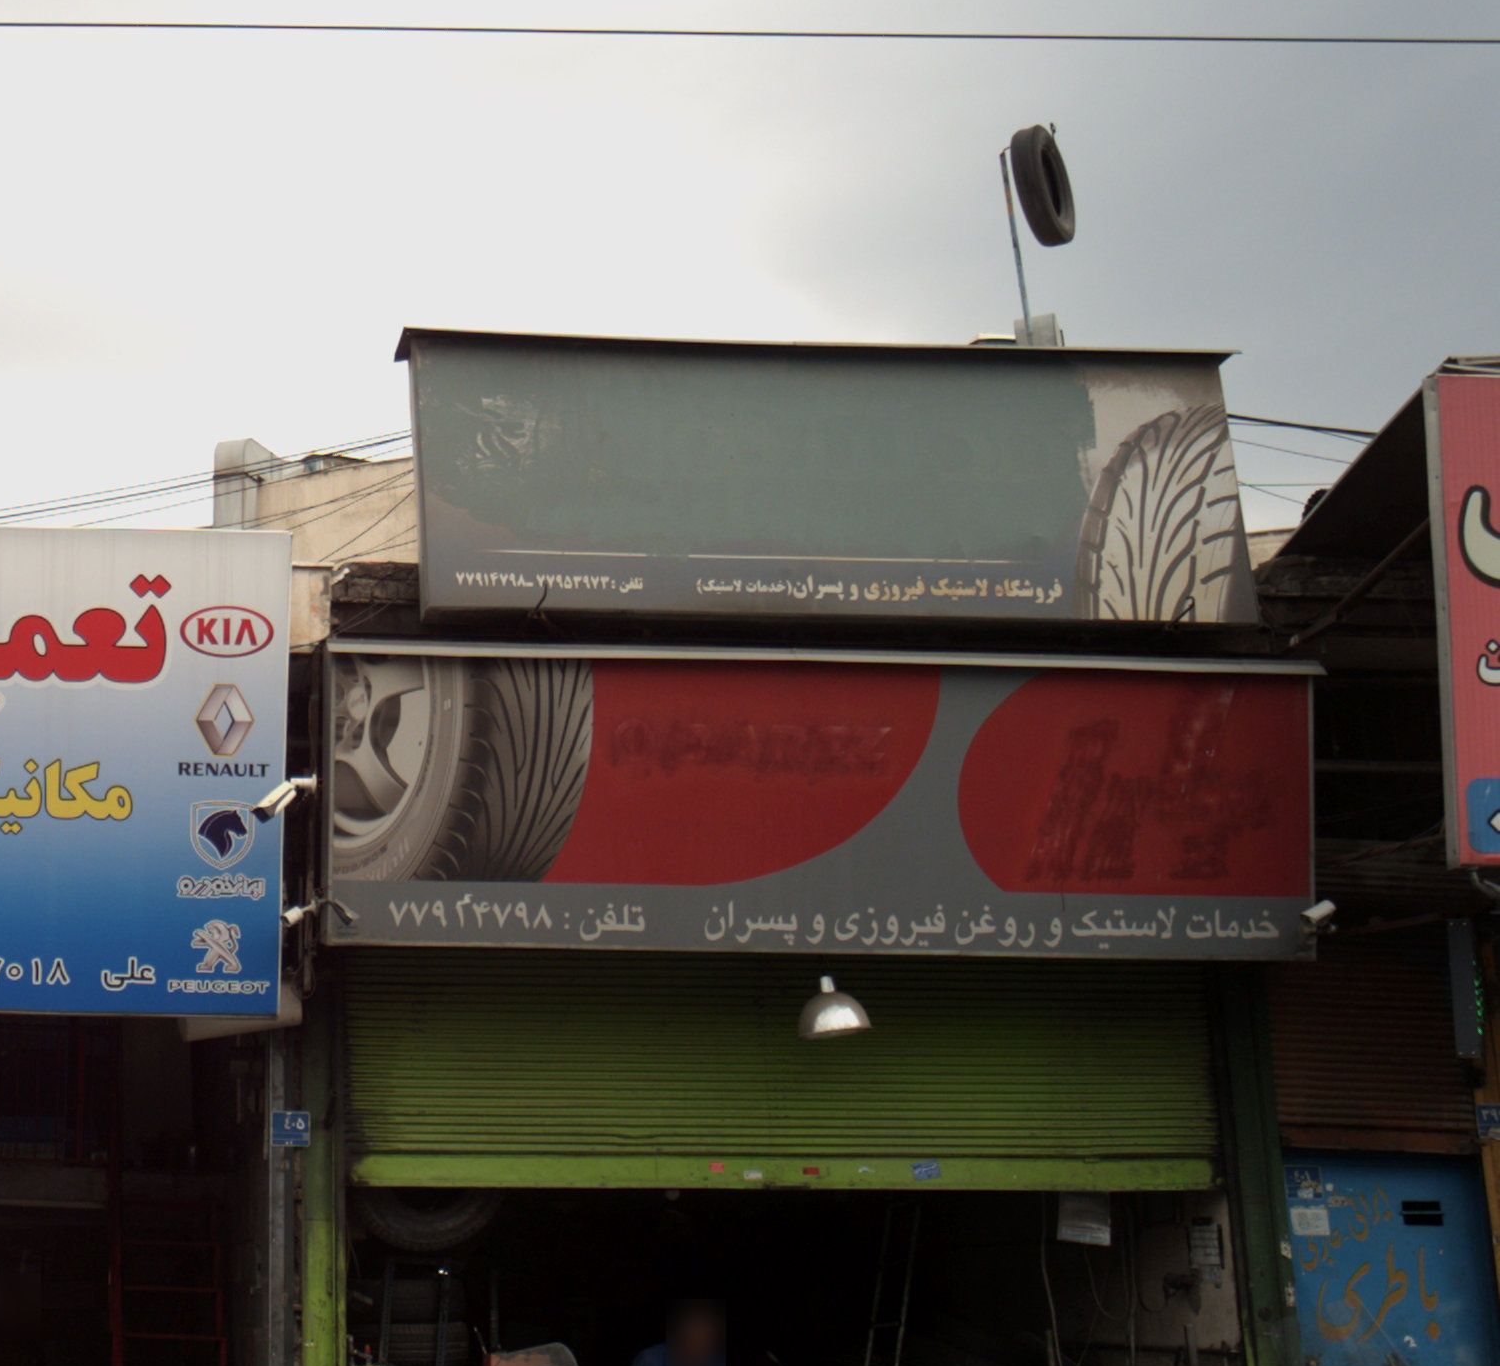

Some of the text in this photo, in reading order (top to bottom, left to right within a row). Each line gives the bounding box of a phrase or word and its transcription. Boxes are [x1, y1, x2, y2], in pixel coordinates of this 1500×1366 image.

[849, 583, 861, 602] و
[863, 575, 926, 602] فیروزی
[930, 577, 989, 602] لاستیک
[994, 577, 1064, 604] فروشگاه
[196, 617, 258, 647] KIA
[177, 761, 270, 778] RENAULT
[703, 900, 1280, 950] خدمات لاستیک و روغن فیروزی و پسران
[101, 957, 156, 991] علی
[167, 979, 270, 994] PEUGEOT
[1316, 1242, 1441, 1345] باطری
